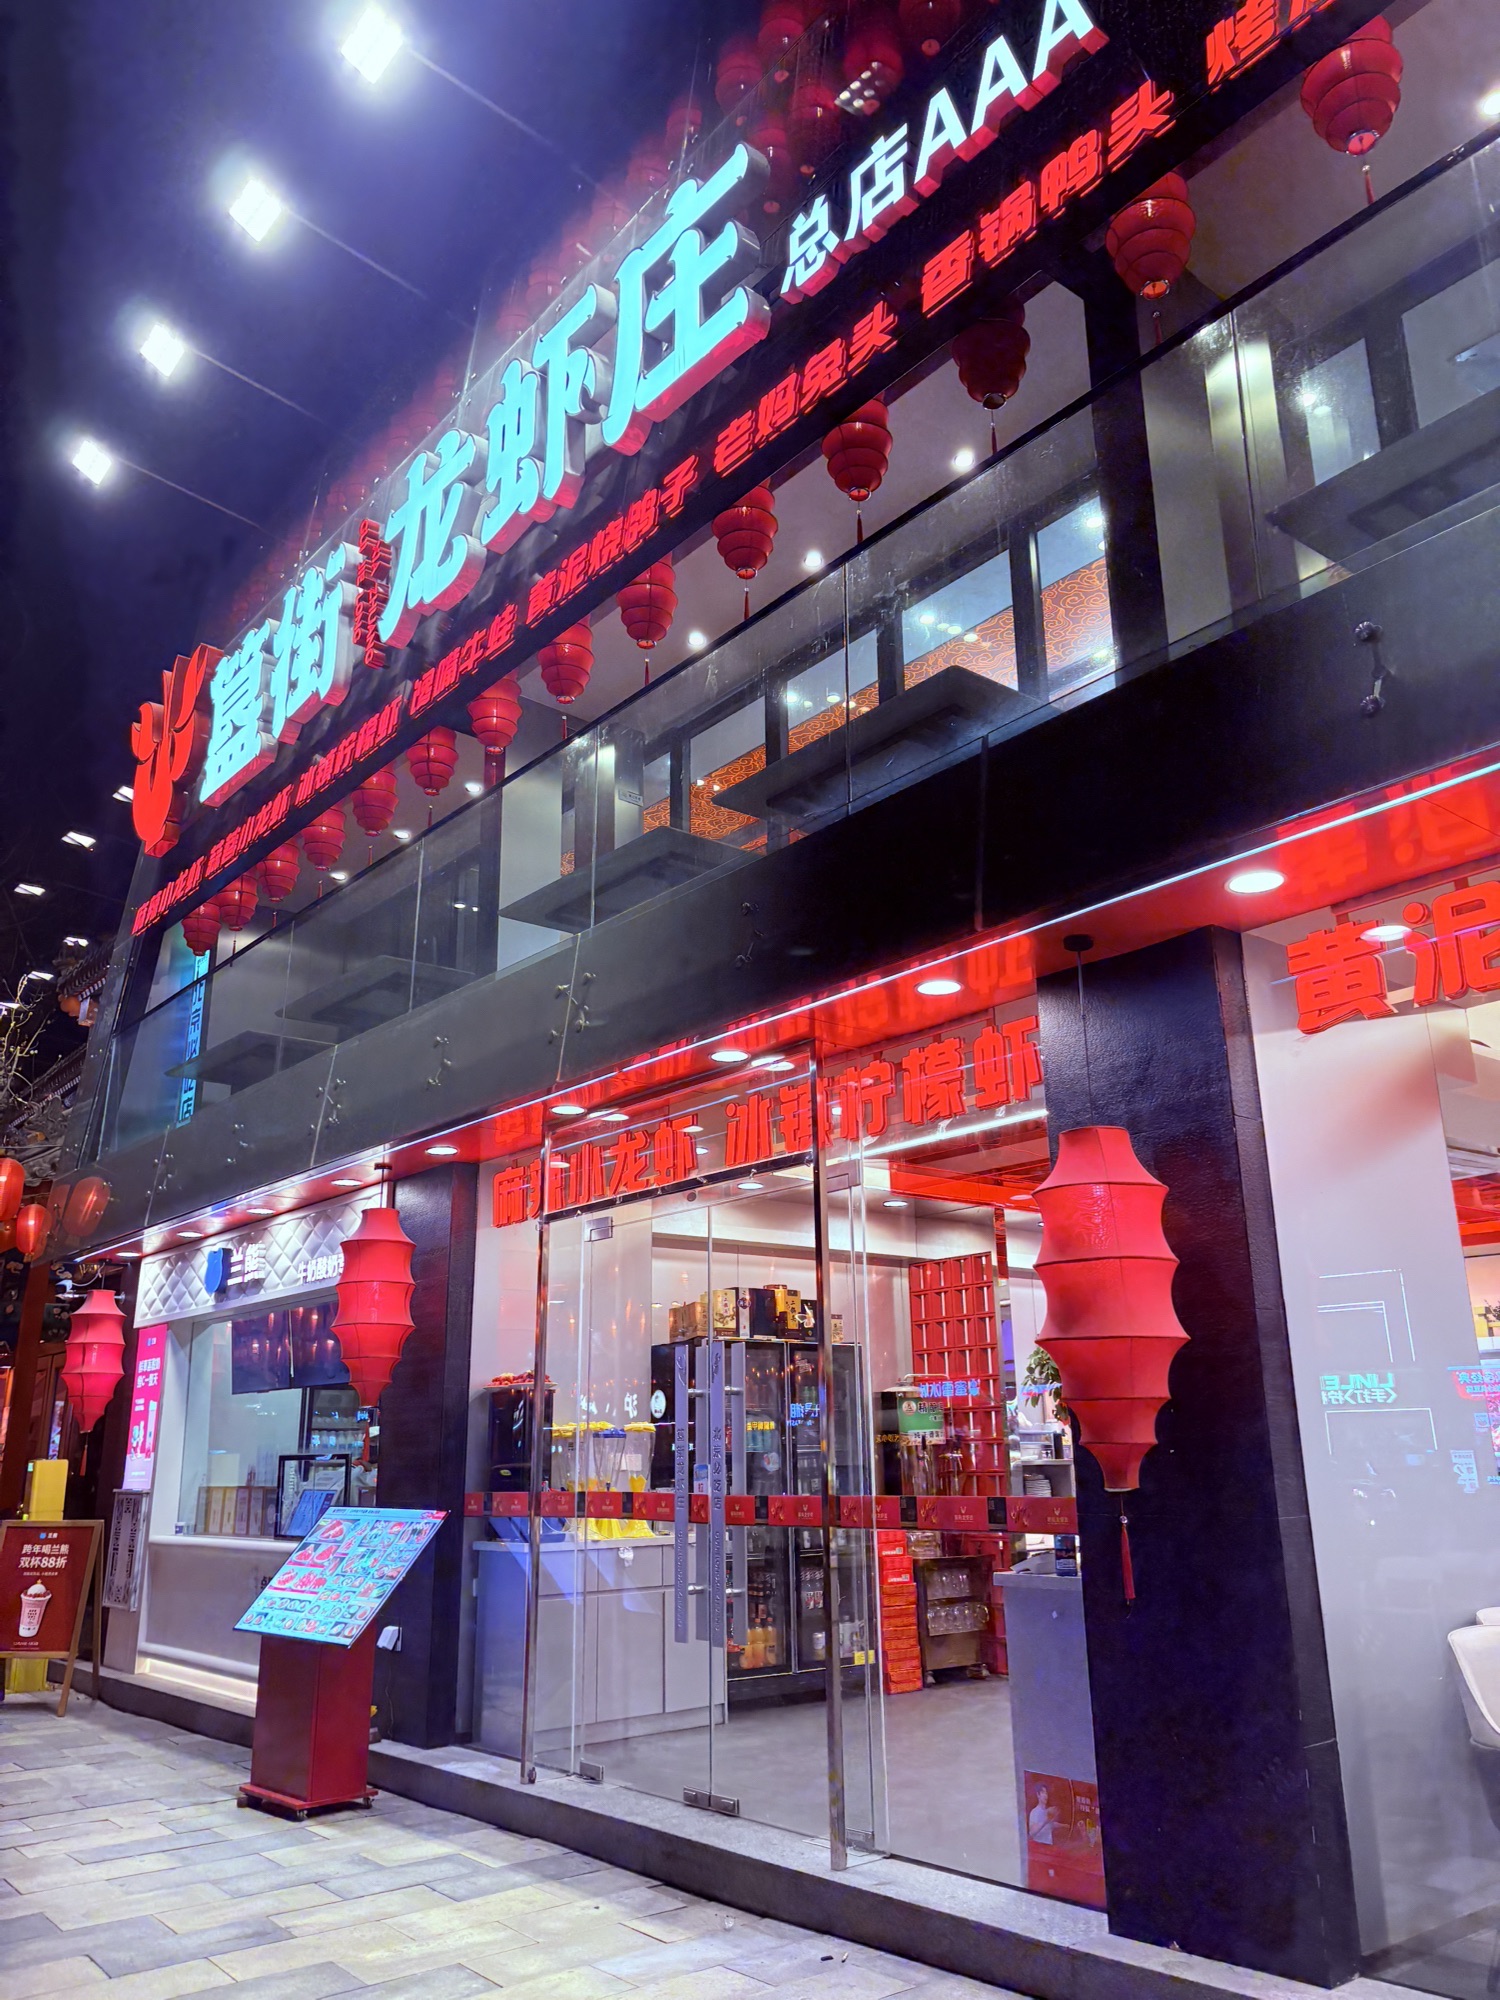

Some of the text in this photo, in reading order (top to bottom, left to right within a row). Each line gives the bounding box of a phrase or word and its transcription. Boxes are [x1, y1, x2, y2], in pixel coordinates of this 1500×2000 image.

[1206, 0, 1327, 86] 烤
[378, 143, 752, 643] 龙虾庄
[410, 603, 517, 717] 馋嘴牛蛙
[527, 453, 700, 625] 黄泥烧鸽子
[715, 300, 897, 475] 老妈兔头
[922, 79, 1173, 314] 香锅鸭头
[491, 1015, 1044, 1228] 麻辣小龙虾 冰镇柠檬虾
[18, 1556, 67, 1569] 双杯88折
[22, 1544, 70, 1555] 跨年喝兰熊
